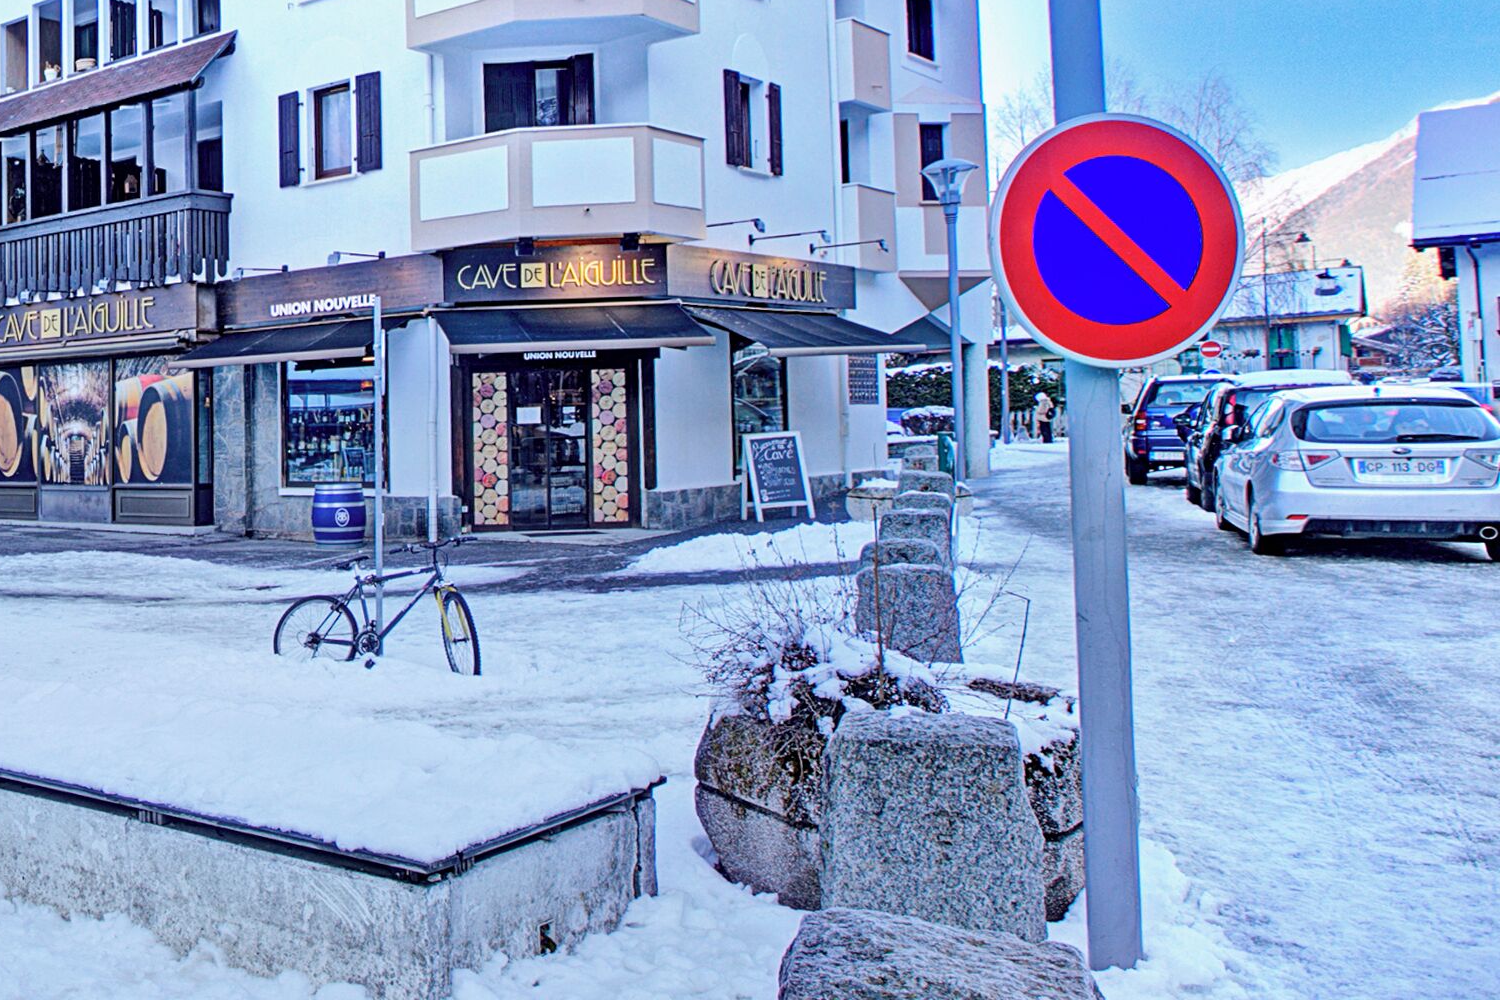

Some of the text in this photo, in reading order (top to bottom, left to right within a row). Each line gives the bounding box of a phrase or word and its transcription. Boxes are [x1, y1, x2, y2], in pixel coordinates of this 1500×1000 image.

[457, 255, 656, 290] CAVE DE L'AIGUILLE
[711, 259, 751, 297] CAVE
[43, 313, 59, 333] DE
[64, 294, 156, 337] L'AIGUILLE
[270, 293, 376, 317] UNION NOUVELLE
[523, 350, 597, 361] UNION NOUVELLE
